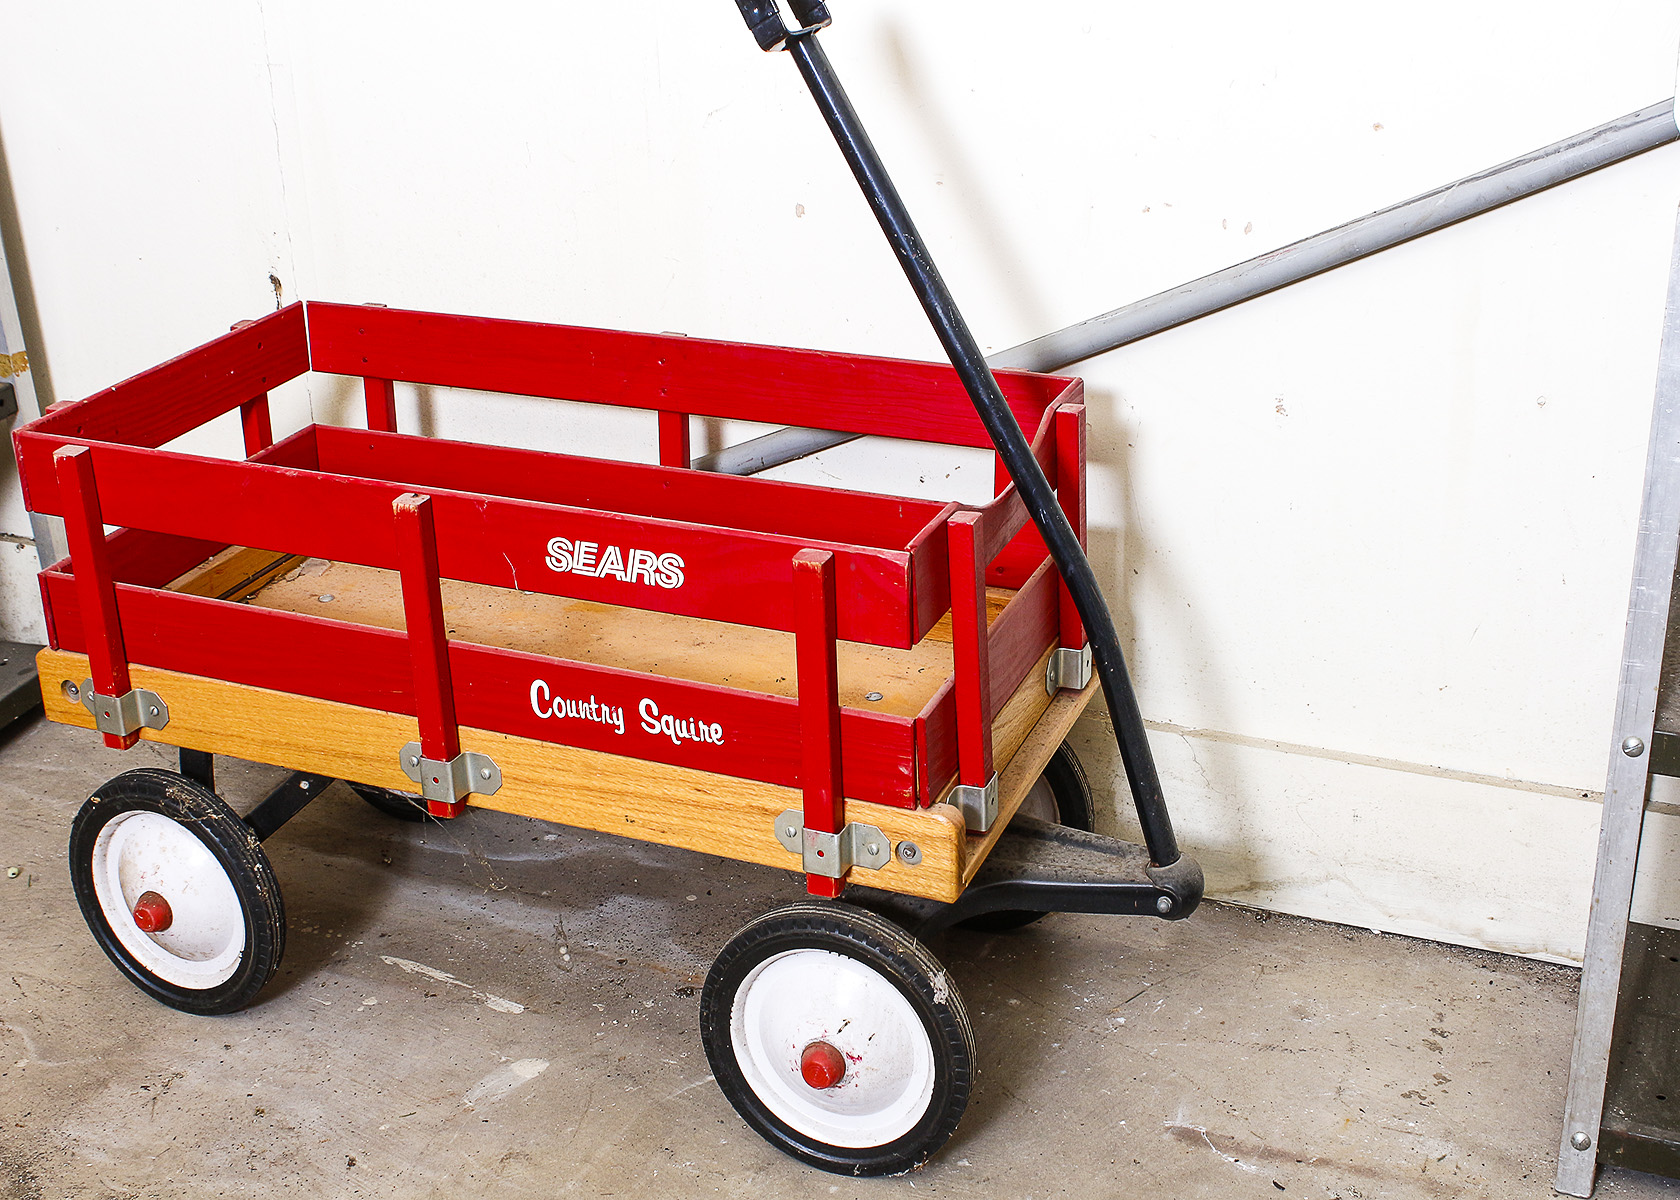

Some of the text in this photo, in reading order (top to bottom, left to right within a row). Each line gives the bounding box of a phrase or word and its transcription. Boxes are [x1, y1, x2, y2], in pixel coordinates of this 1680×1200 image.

[545, 537, 685, 589] SEARS
[530, 679, 725, 746] Country Squire
